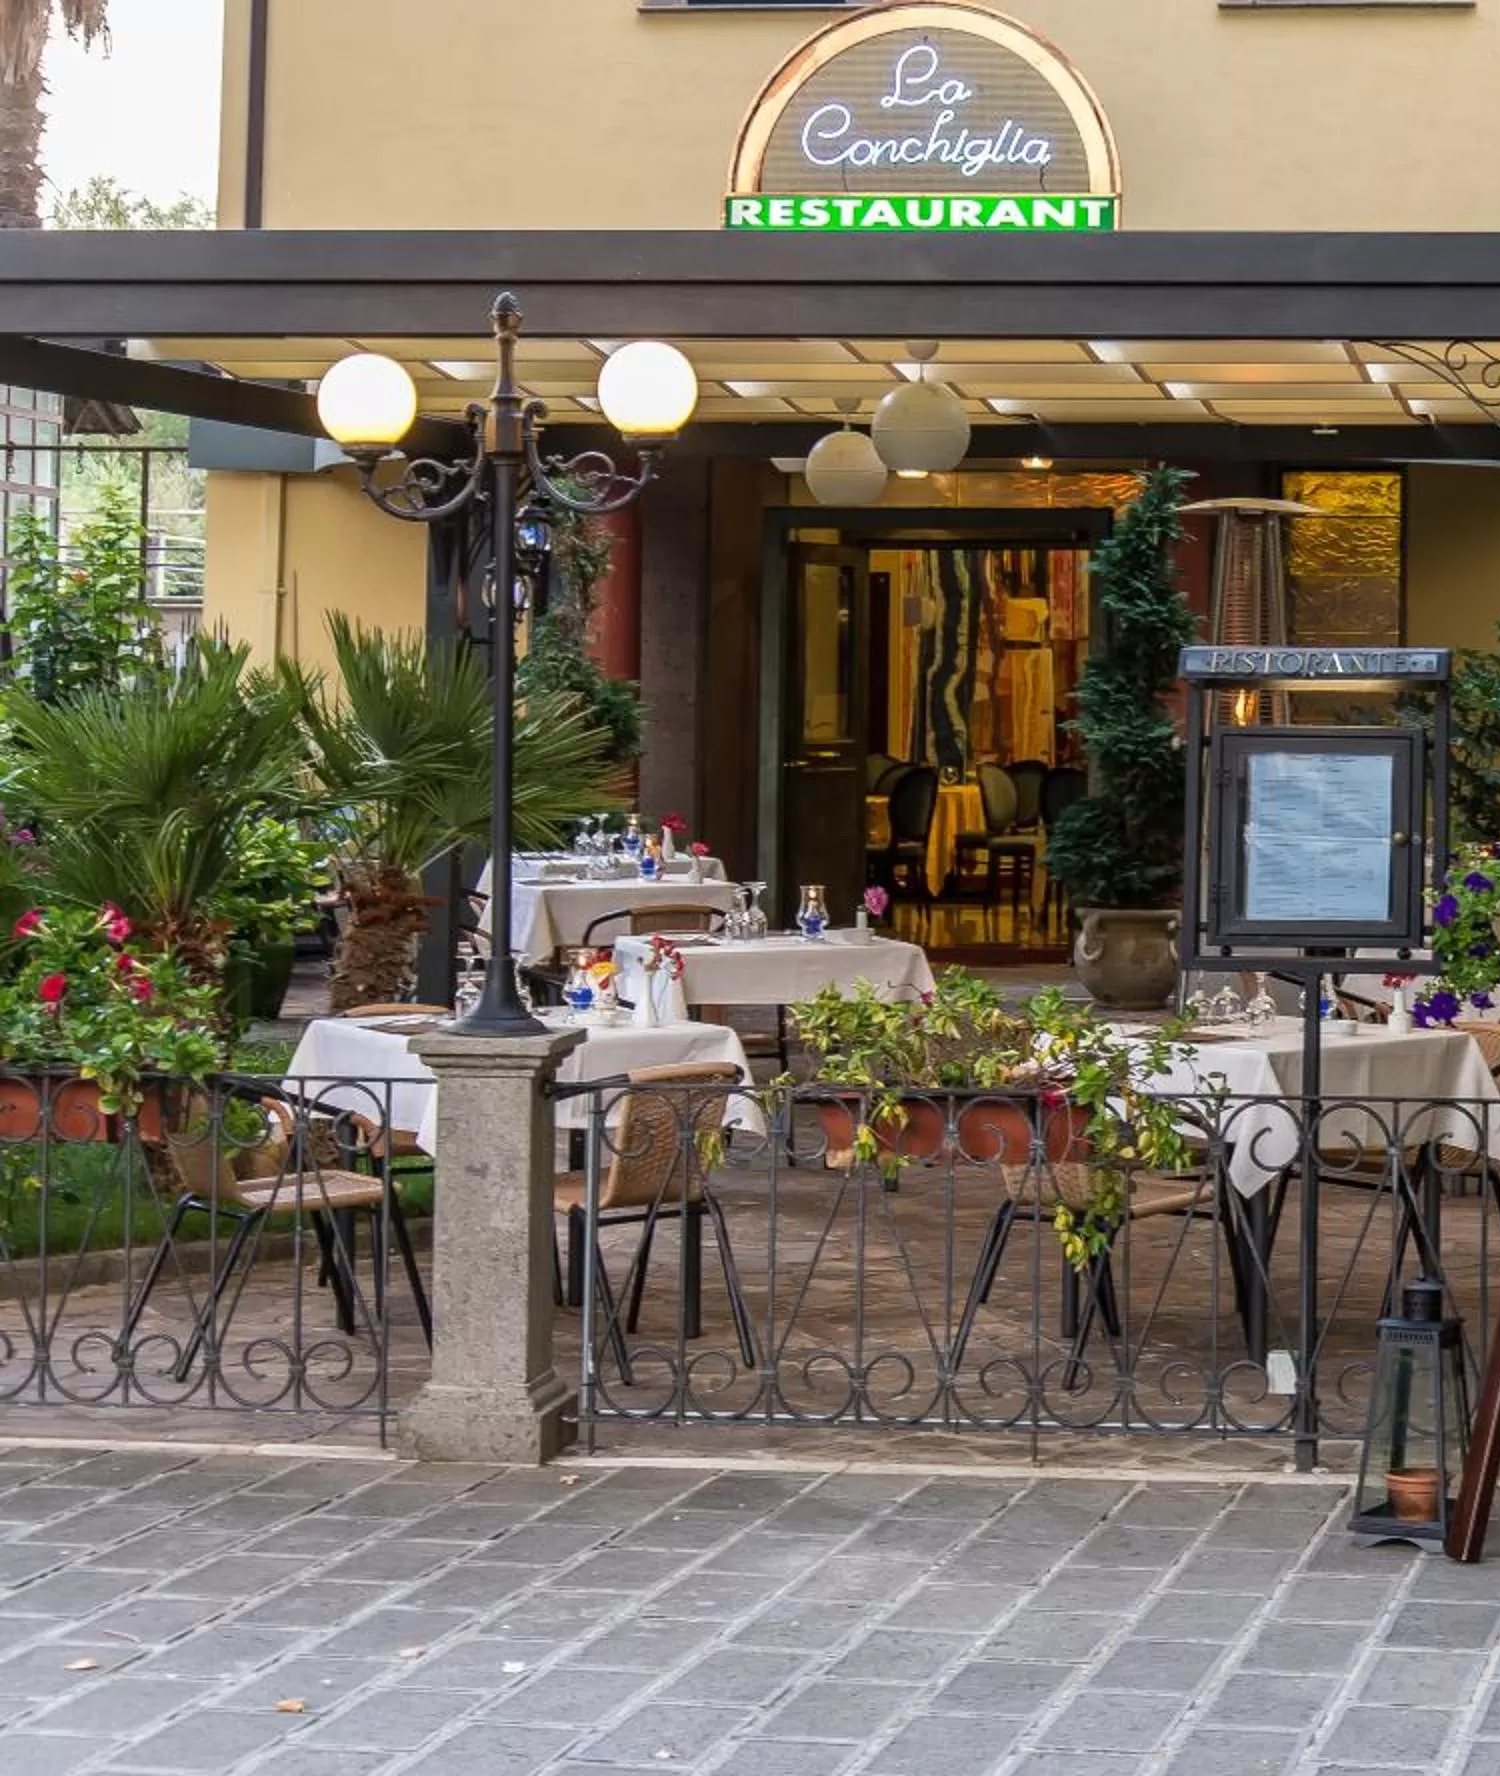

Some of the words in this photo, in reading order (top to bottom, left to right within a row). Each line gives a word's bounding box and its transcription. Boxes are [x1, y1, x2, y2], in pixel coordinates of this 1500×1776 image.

[880, 45, 973, 107] La
[801, 104, 1053, 176] Conchiglia
[731, 199, 1112, 227] RESTAURANT
[1210, 652, 1409, 674] RISTORANTE
